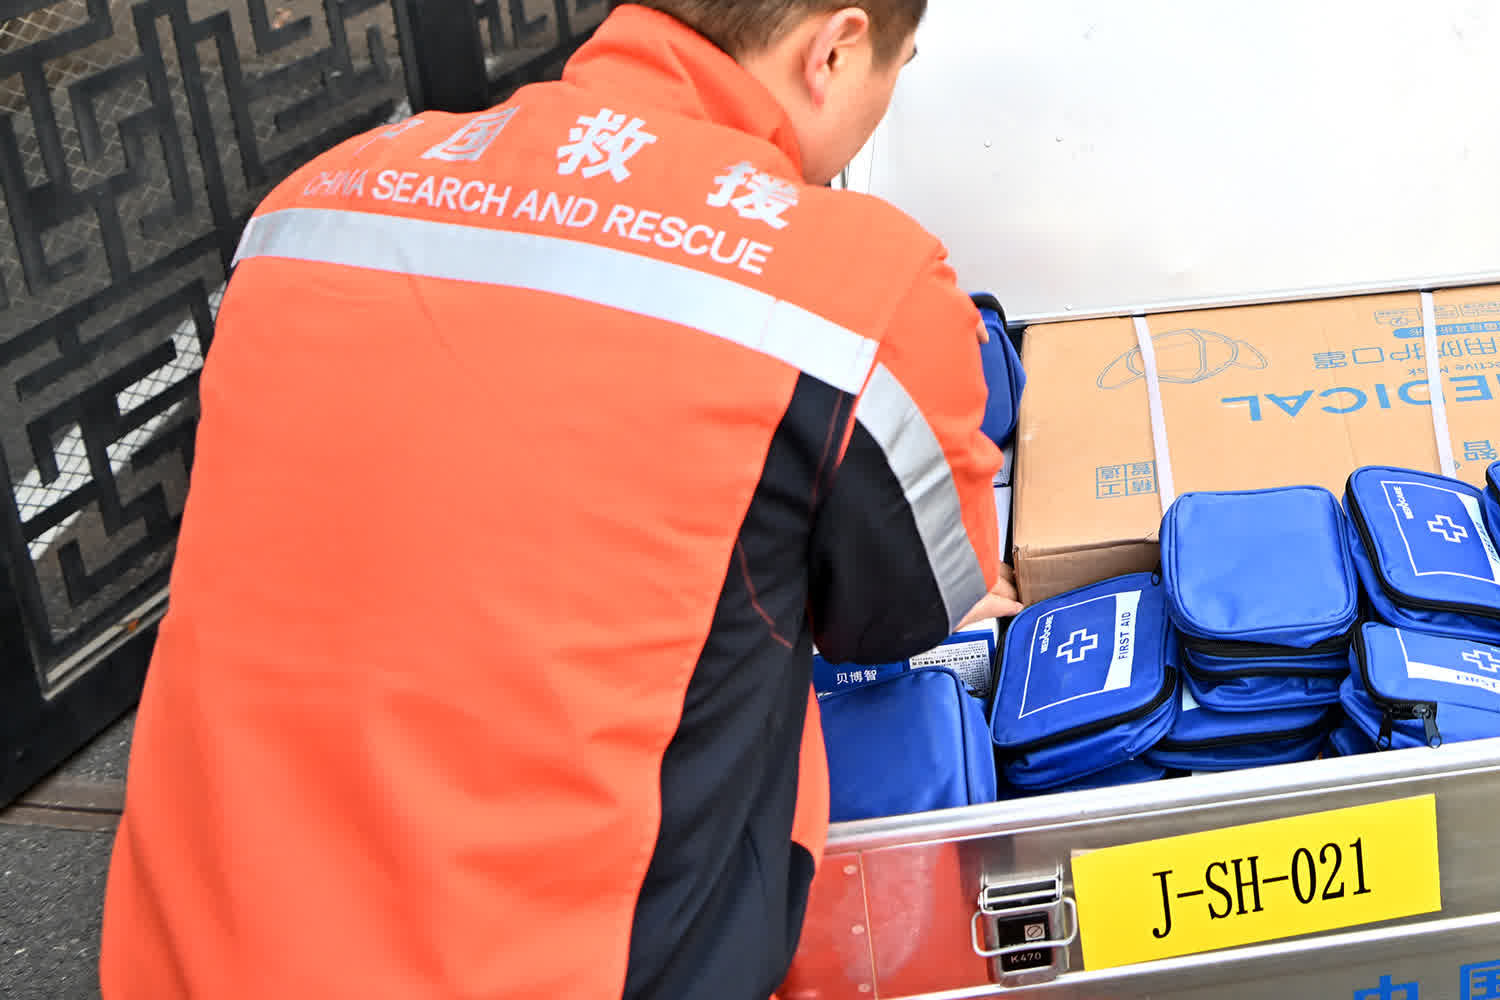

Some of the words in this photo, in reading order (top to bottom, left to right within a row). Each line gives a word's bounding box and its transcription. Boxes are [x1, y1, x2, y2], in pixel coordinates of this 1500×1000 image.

[303, 169, 369, 198] CHINA
[372, 169, 512, 217] SEARCH
[512, 187, 599, 228] AND
[602, 204, 773, 275] RESCUE
[1408, 363, 1450, 377] Msk
[1120, 611, 1131, 627] AID
[1118, 631, 1131, 660] FIRST
[836, 669, 878, 685] 贝博智
[1151, 836, 1372, 939] J-SH-021
[1010, 951, 1042, 964] K470
